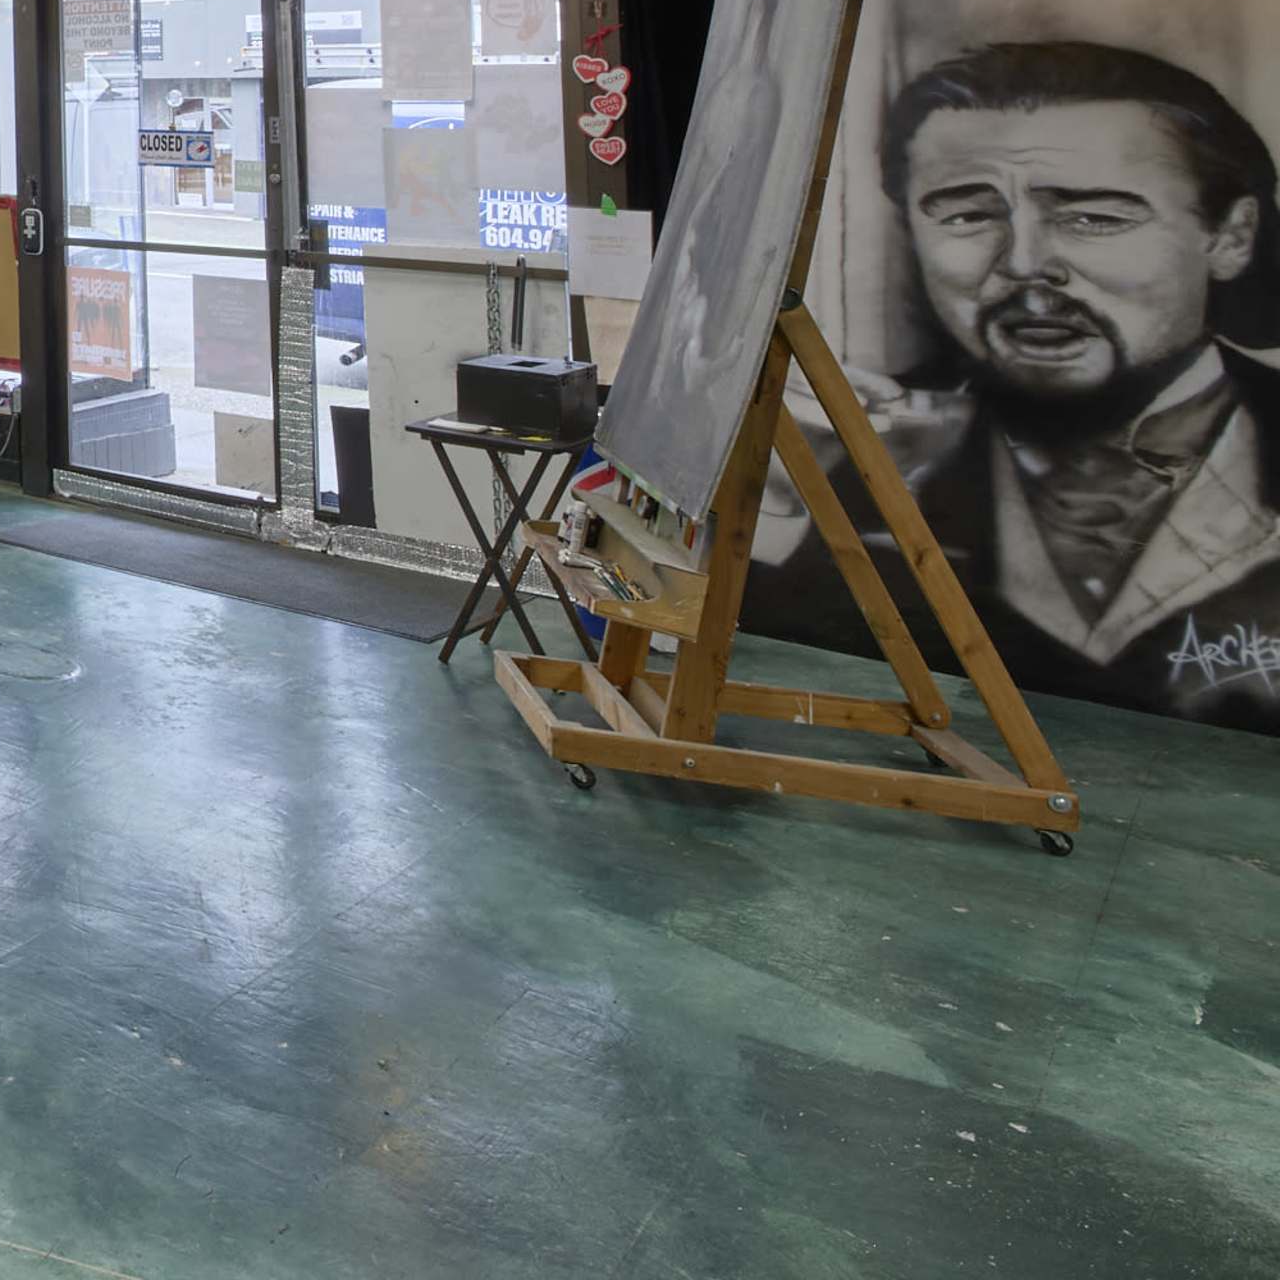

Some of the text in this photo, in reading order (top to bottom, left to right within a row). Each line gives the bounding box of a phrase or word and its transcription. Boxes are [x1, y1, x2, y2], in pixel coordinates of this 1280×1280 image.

[596, 96, 618, 108] LOVE
[600, 103, 620, 114] YOU
[140, 134, 183, 152] CLOSED
[486, 202, 537, 225] LEAK
